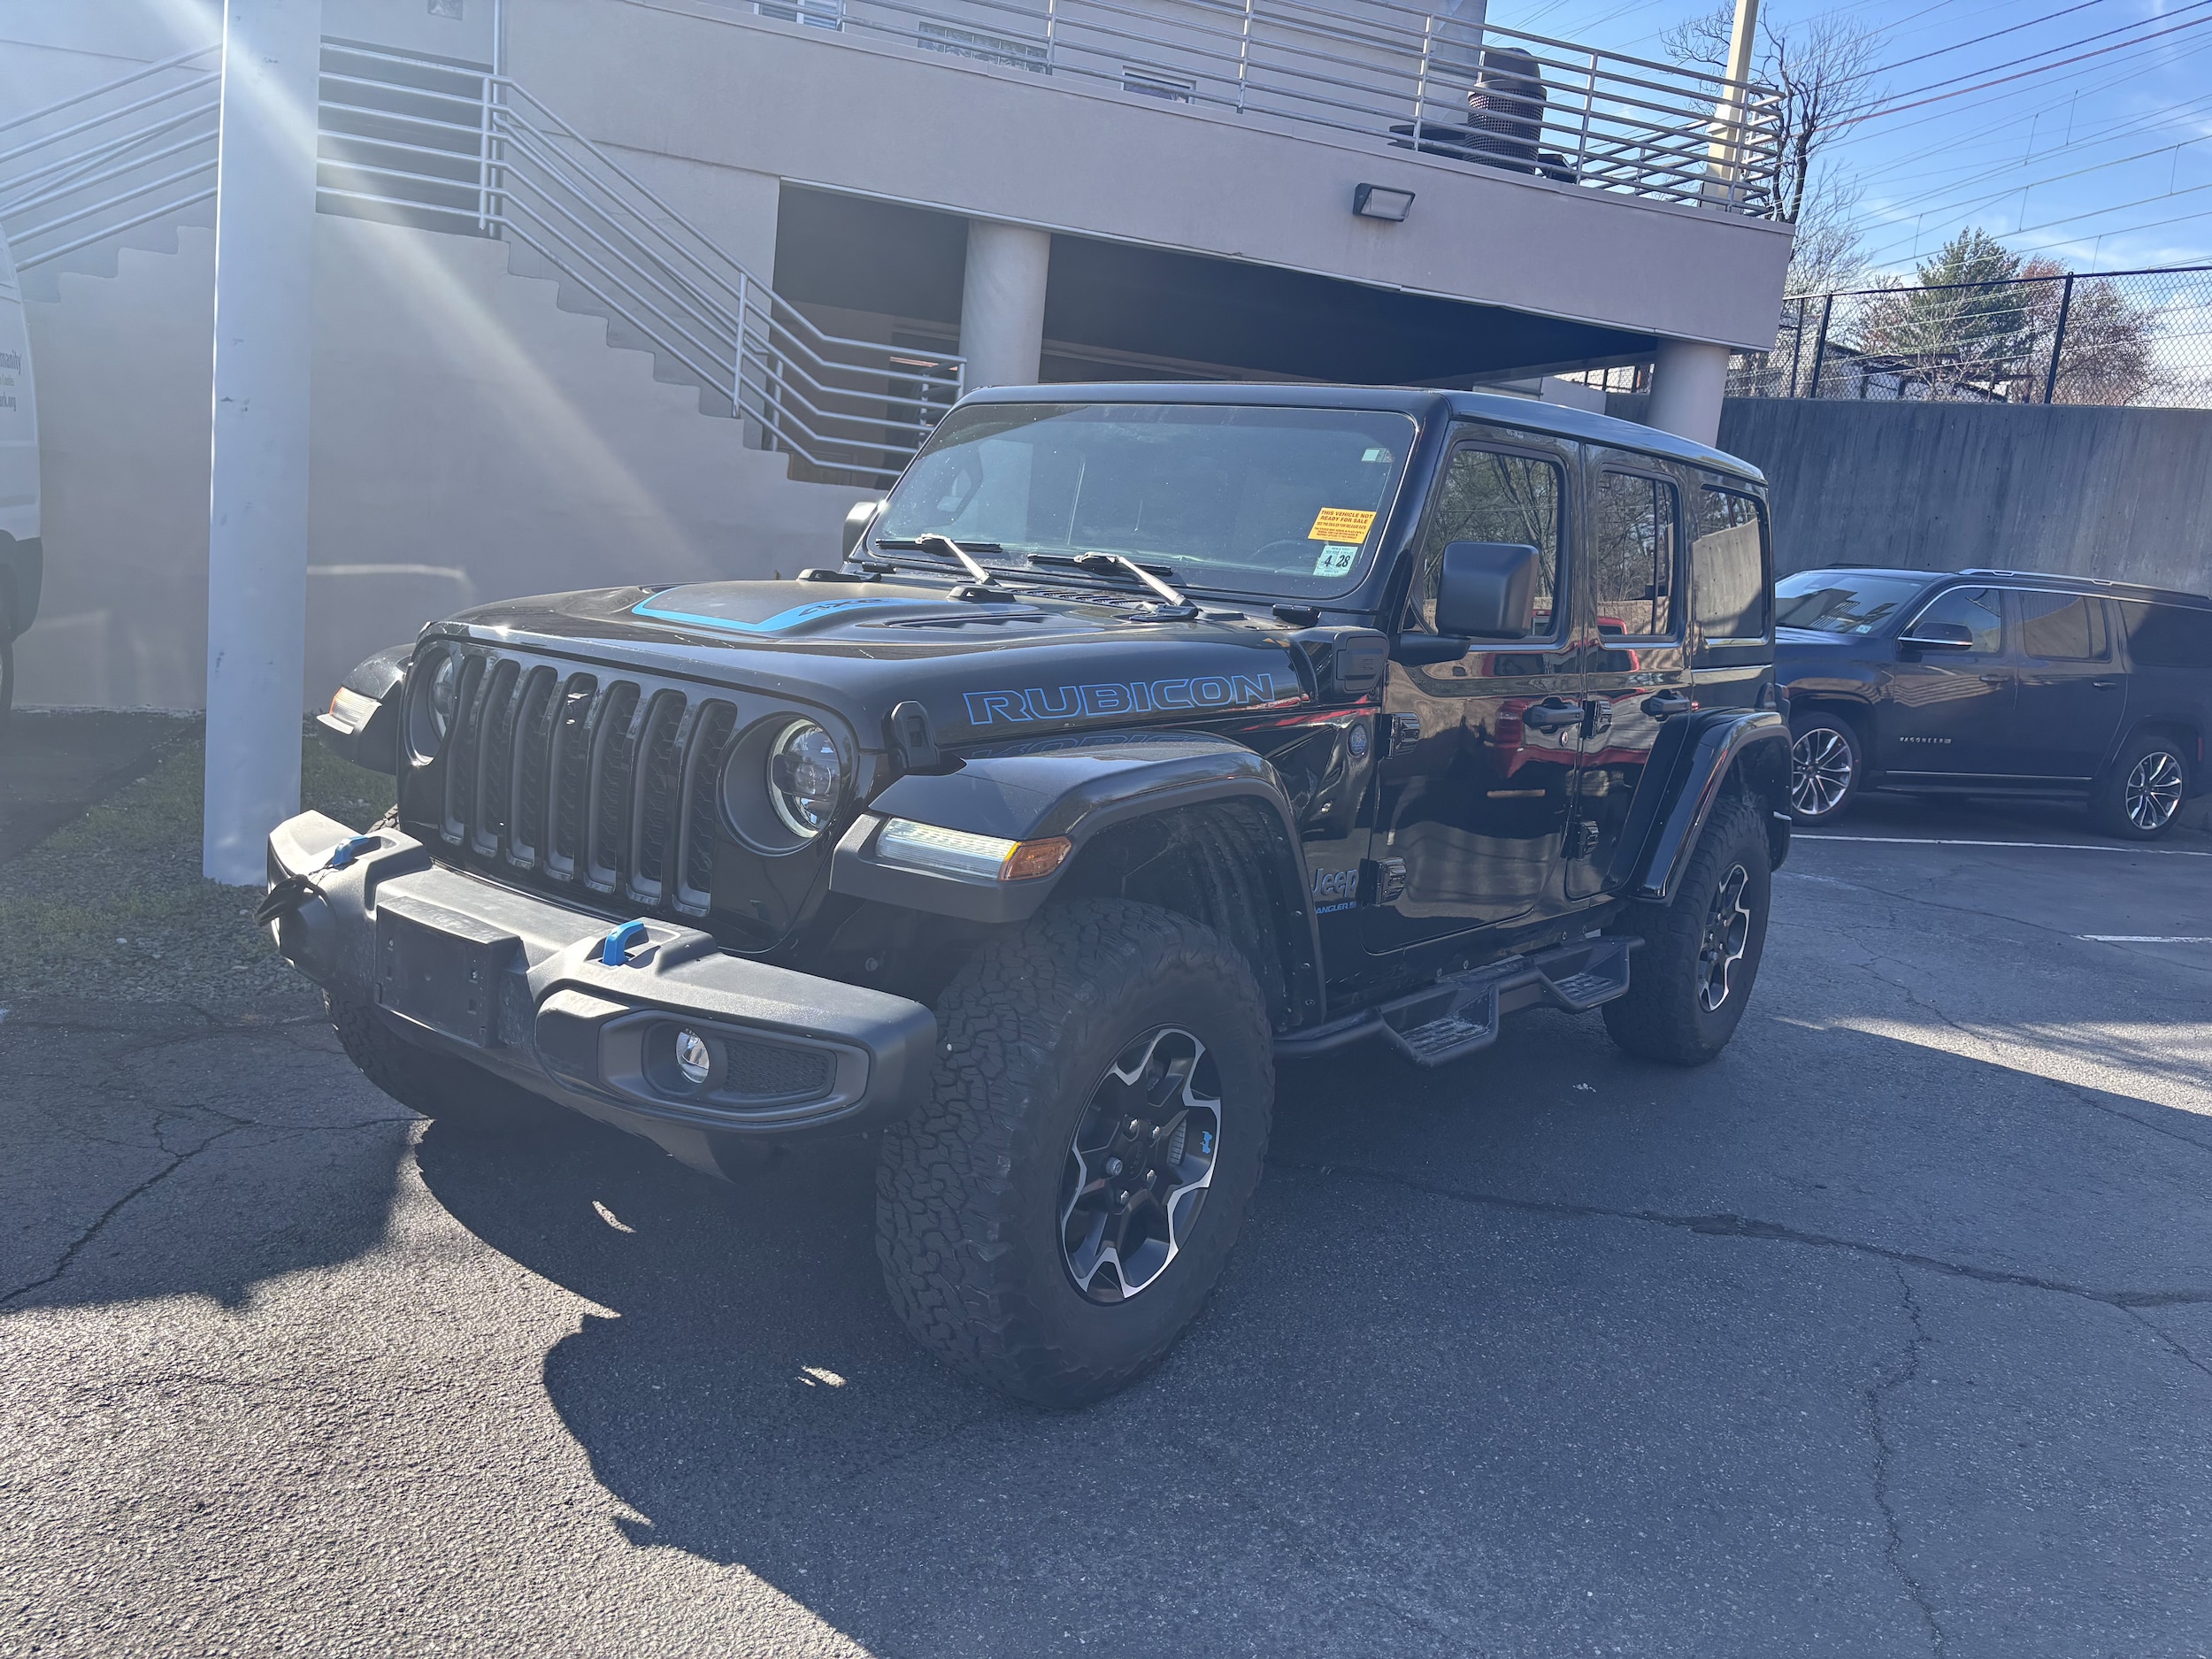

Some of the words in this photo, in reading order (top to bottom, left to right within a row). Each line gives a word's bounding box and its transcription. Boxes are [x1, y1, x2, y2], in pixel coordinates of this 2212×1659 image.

[1324, 555, 1333, 567] 4
[1336, 555, 1351, 567] 28
[963, 673, 1274, 725] RUBICON
[1312, 868, 1359, 897] Jeep
